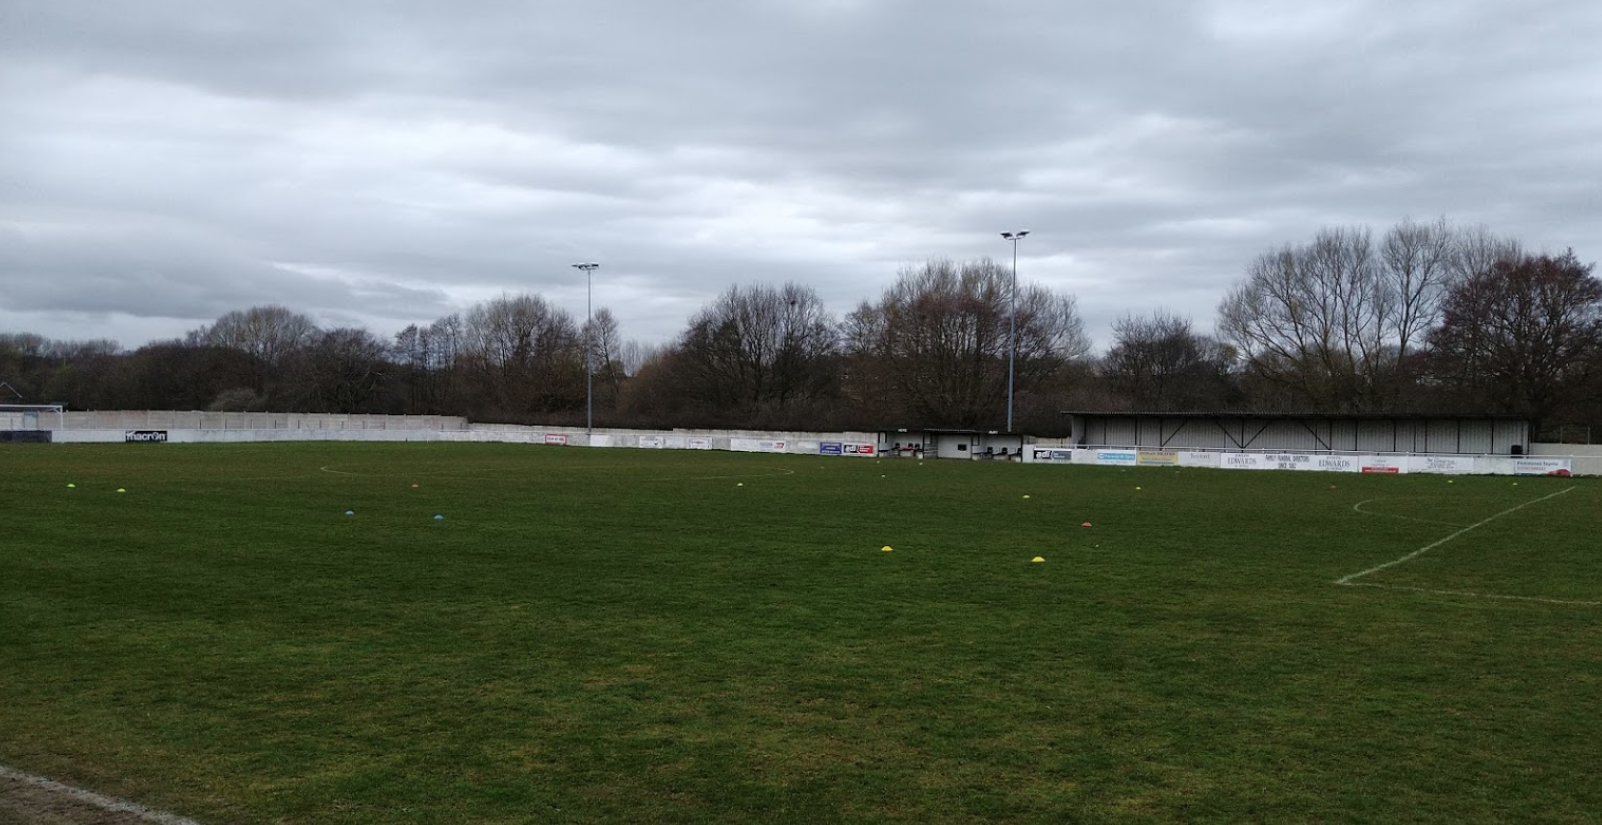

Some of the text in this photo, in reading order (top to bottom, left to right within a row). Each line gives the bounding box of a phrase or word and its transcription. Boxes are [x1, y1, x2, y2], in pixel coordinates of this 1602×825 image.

[126, 431, 166, 441] macron
[1228, 457, 1257, 465] EDWARDS
[1319, 459, 1350, 468] EDWARDS
